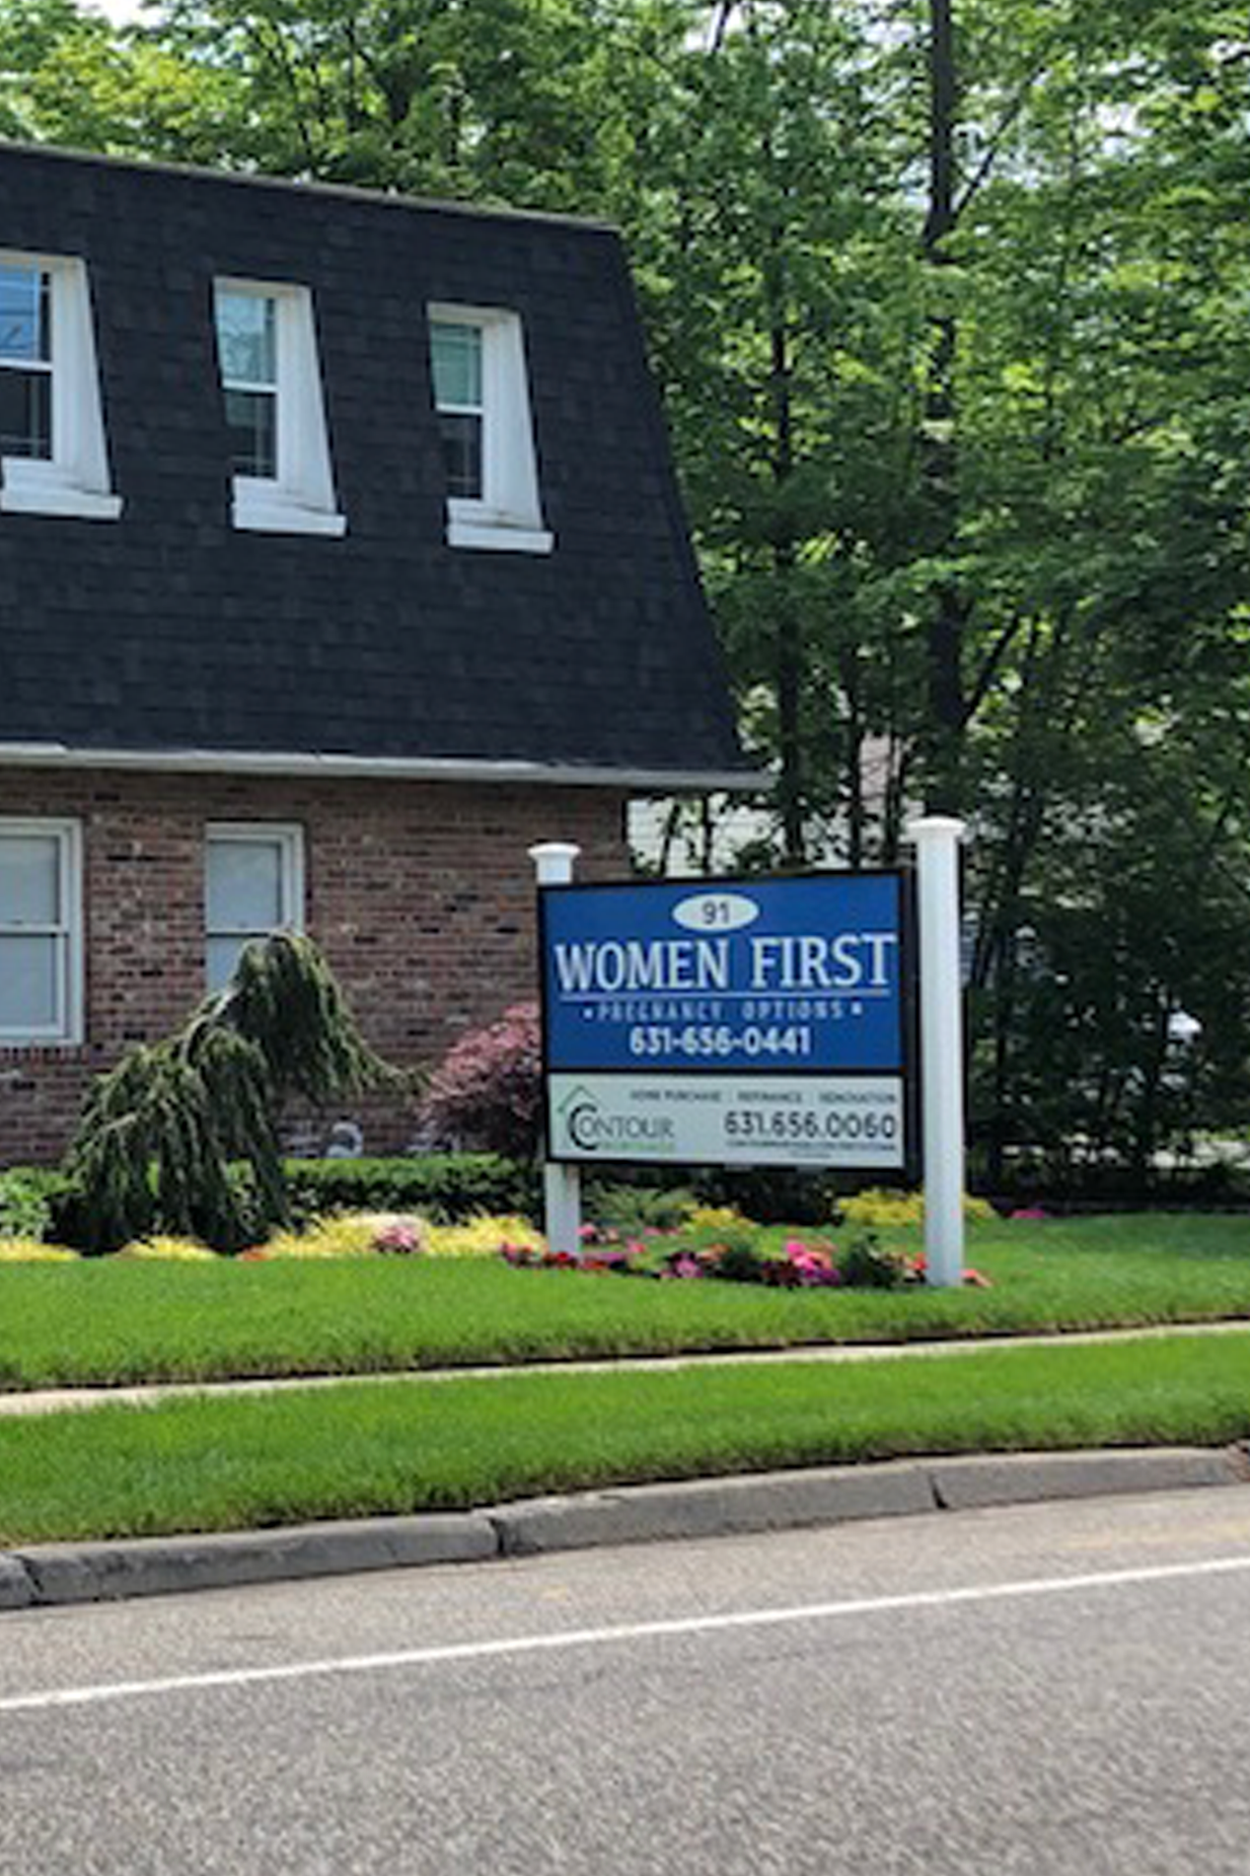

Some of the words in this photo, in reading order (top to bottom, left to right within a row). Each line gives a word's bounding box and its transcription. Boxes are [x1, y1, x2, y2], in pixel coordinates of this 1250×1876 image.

[701, 901, 731, 924] 91
[554, 938, 730, 991] WOMEN
[751, 932, 898, 988] FIRST
[598, 1001, 722, 1021] PREGNANCY
[743, 1001, 845, 1019] OPTIONS
[629, 1026, 811, 1055] 631-656-0441
[724, 1110, 897, 1139] 631.656.0060
